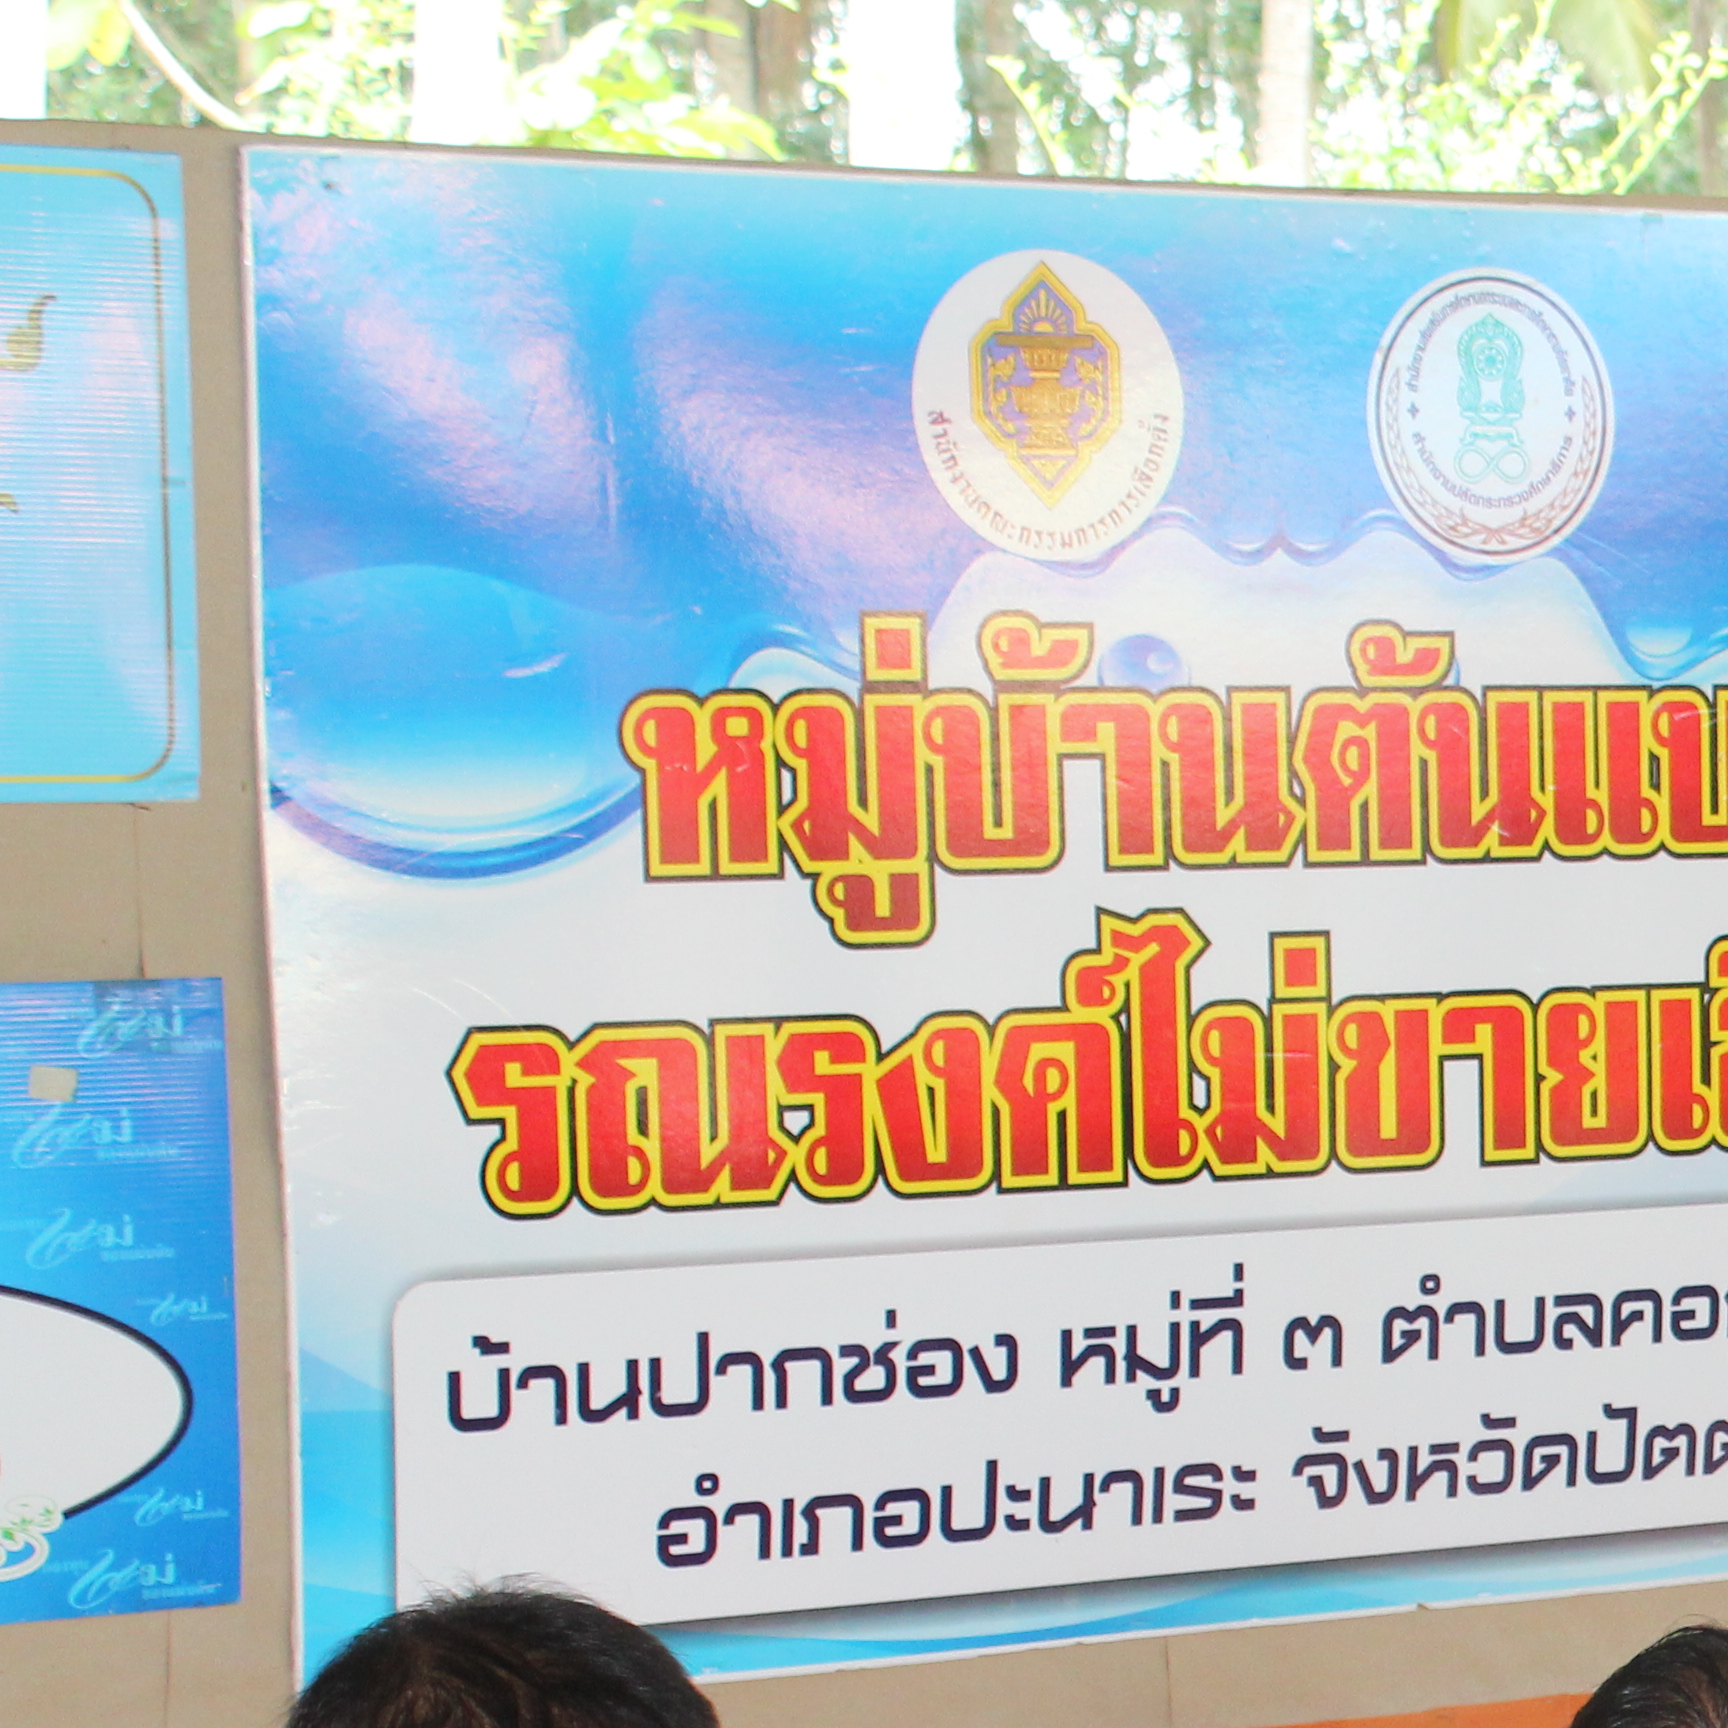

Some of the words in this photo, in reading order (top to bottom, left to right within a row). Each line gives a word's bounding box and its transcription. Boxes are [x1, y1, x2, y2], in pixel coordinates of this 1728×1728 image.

[445, 1312, 1020, 1435] บ้านปากช่อง
[1059, 1265, 1245, 1420] หมู่ที่
[1284, 1314, 1343, 1371] ๓
[654, 1450, 1260, 1573] อำเภอปะนาเระ
